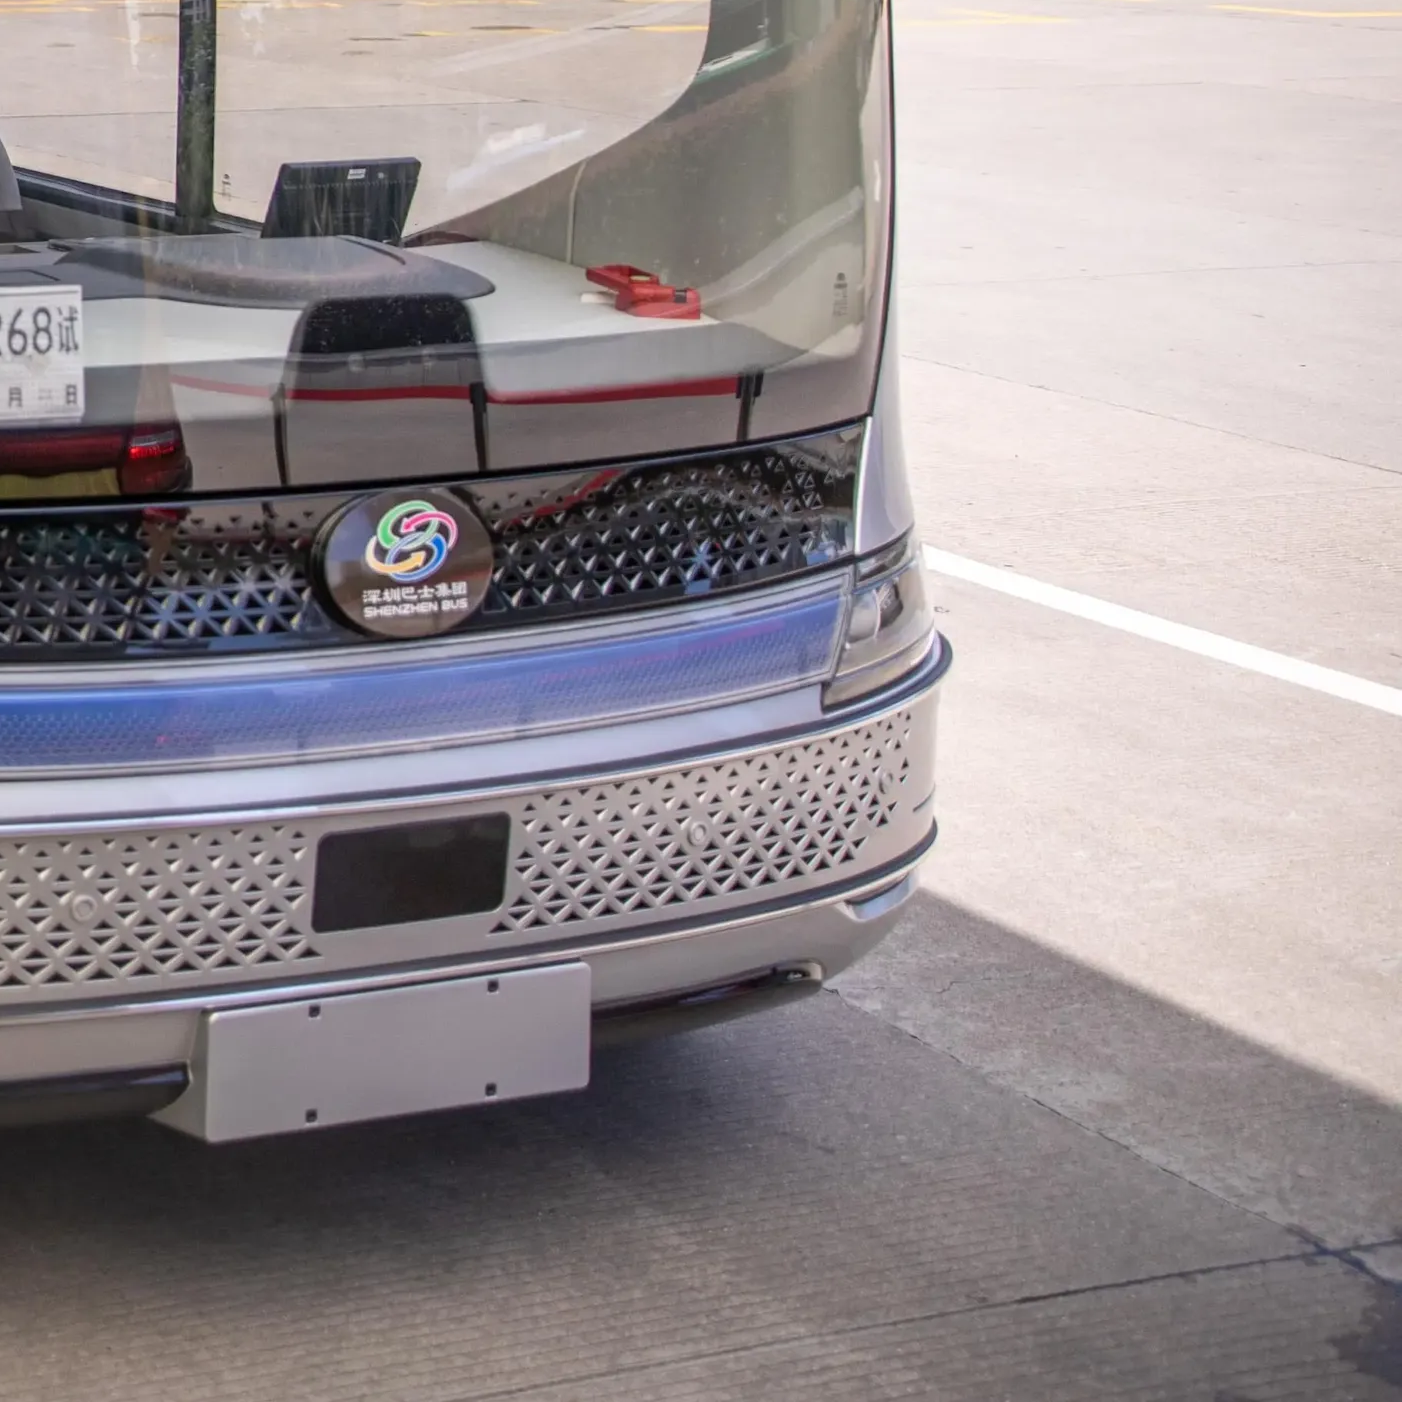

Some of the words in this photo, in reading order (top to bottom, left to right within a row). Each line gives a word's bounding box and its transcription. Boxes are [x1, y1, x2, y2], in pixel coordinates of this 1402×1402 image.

[65, 383, 78, 406] 日
[363, 601, 438, 618] SHENZHEN
[441, 598, 468, 611] BUS
